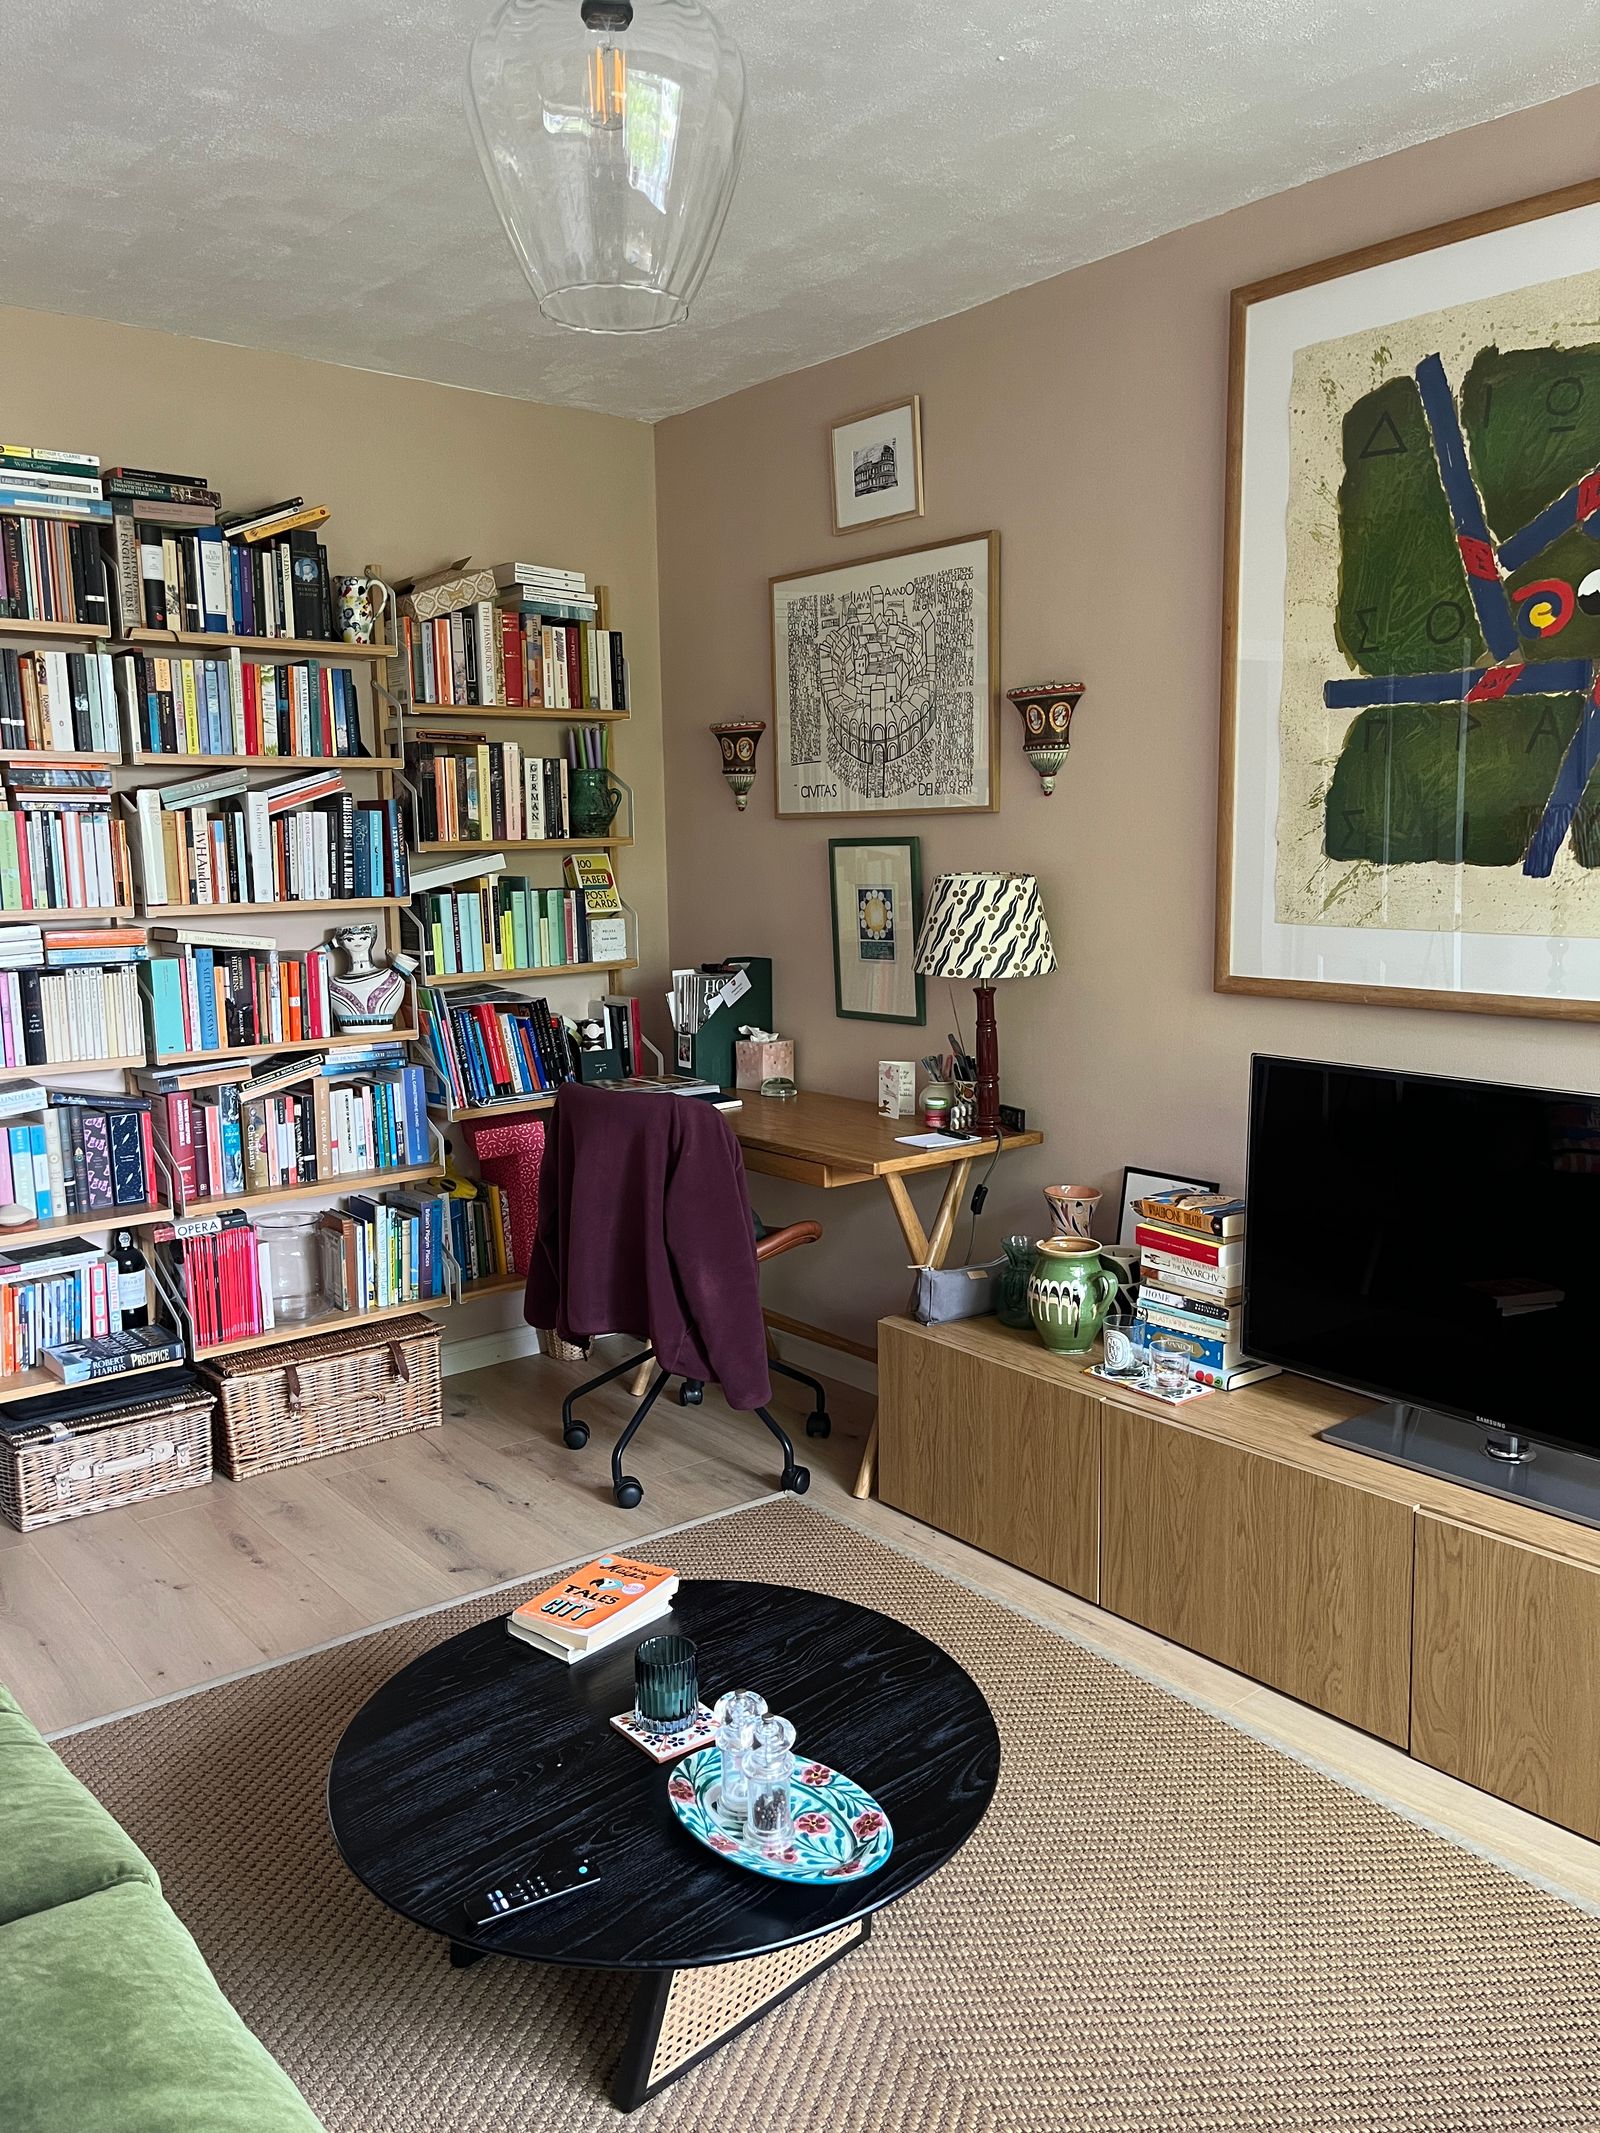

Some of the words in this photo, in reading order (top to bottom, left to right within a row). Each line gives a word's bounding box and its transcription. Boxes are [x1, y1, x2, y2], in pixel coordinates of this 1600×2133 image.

[120, 533, 130, 579] ENGLISH
[125, 583, 134, 614] VERSE
[130, 547, 138, 587] OXFORD
[482, 607, 490, 622] THE
[484, 624, 492, 672] HABSBURGS
[530, 763, 538, 821] GERMAN
[801, 784, 837, 799] CIVITAS
[919, 783, 933, 796] DEI
[342, 796, 352, 838] CONFESSIONS
[255, 804, 266, 850] Isherwood
[577, 860, 591, 869] 100
[581, 875, 608, 885] FABER
[586, 891, 610, 900] POST-
[588, 899, 618, 909] CARDS
[203, 967, 212, 1007] SELECTED
[206, 1010, 214, 1037] ESSAYS
[294, 1062, 310, 1071] MORTAL
[1148, 1204, 1180, 1222] WHALEBONE
[1184, 1212, 1202, 1229] THEATRE
[178, 1221, 218, 1236] OPERA
[1181, 1265, 1220, 1282] ANARCHY
[1145, 1289, 1169, 1302] HOME
[92, 1355, 125, 1369] ROBERT
[130, 1348, 170, 1368] PRECIPICE
[94, 1364, 126, 1377] HARRIS
[1475, 1415, 1506, 1430] SAMSUNG
[564, 1584, 620, 1605] TALES
[541, 1598, 596, 1621] CITY
